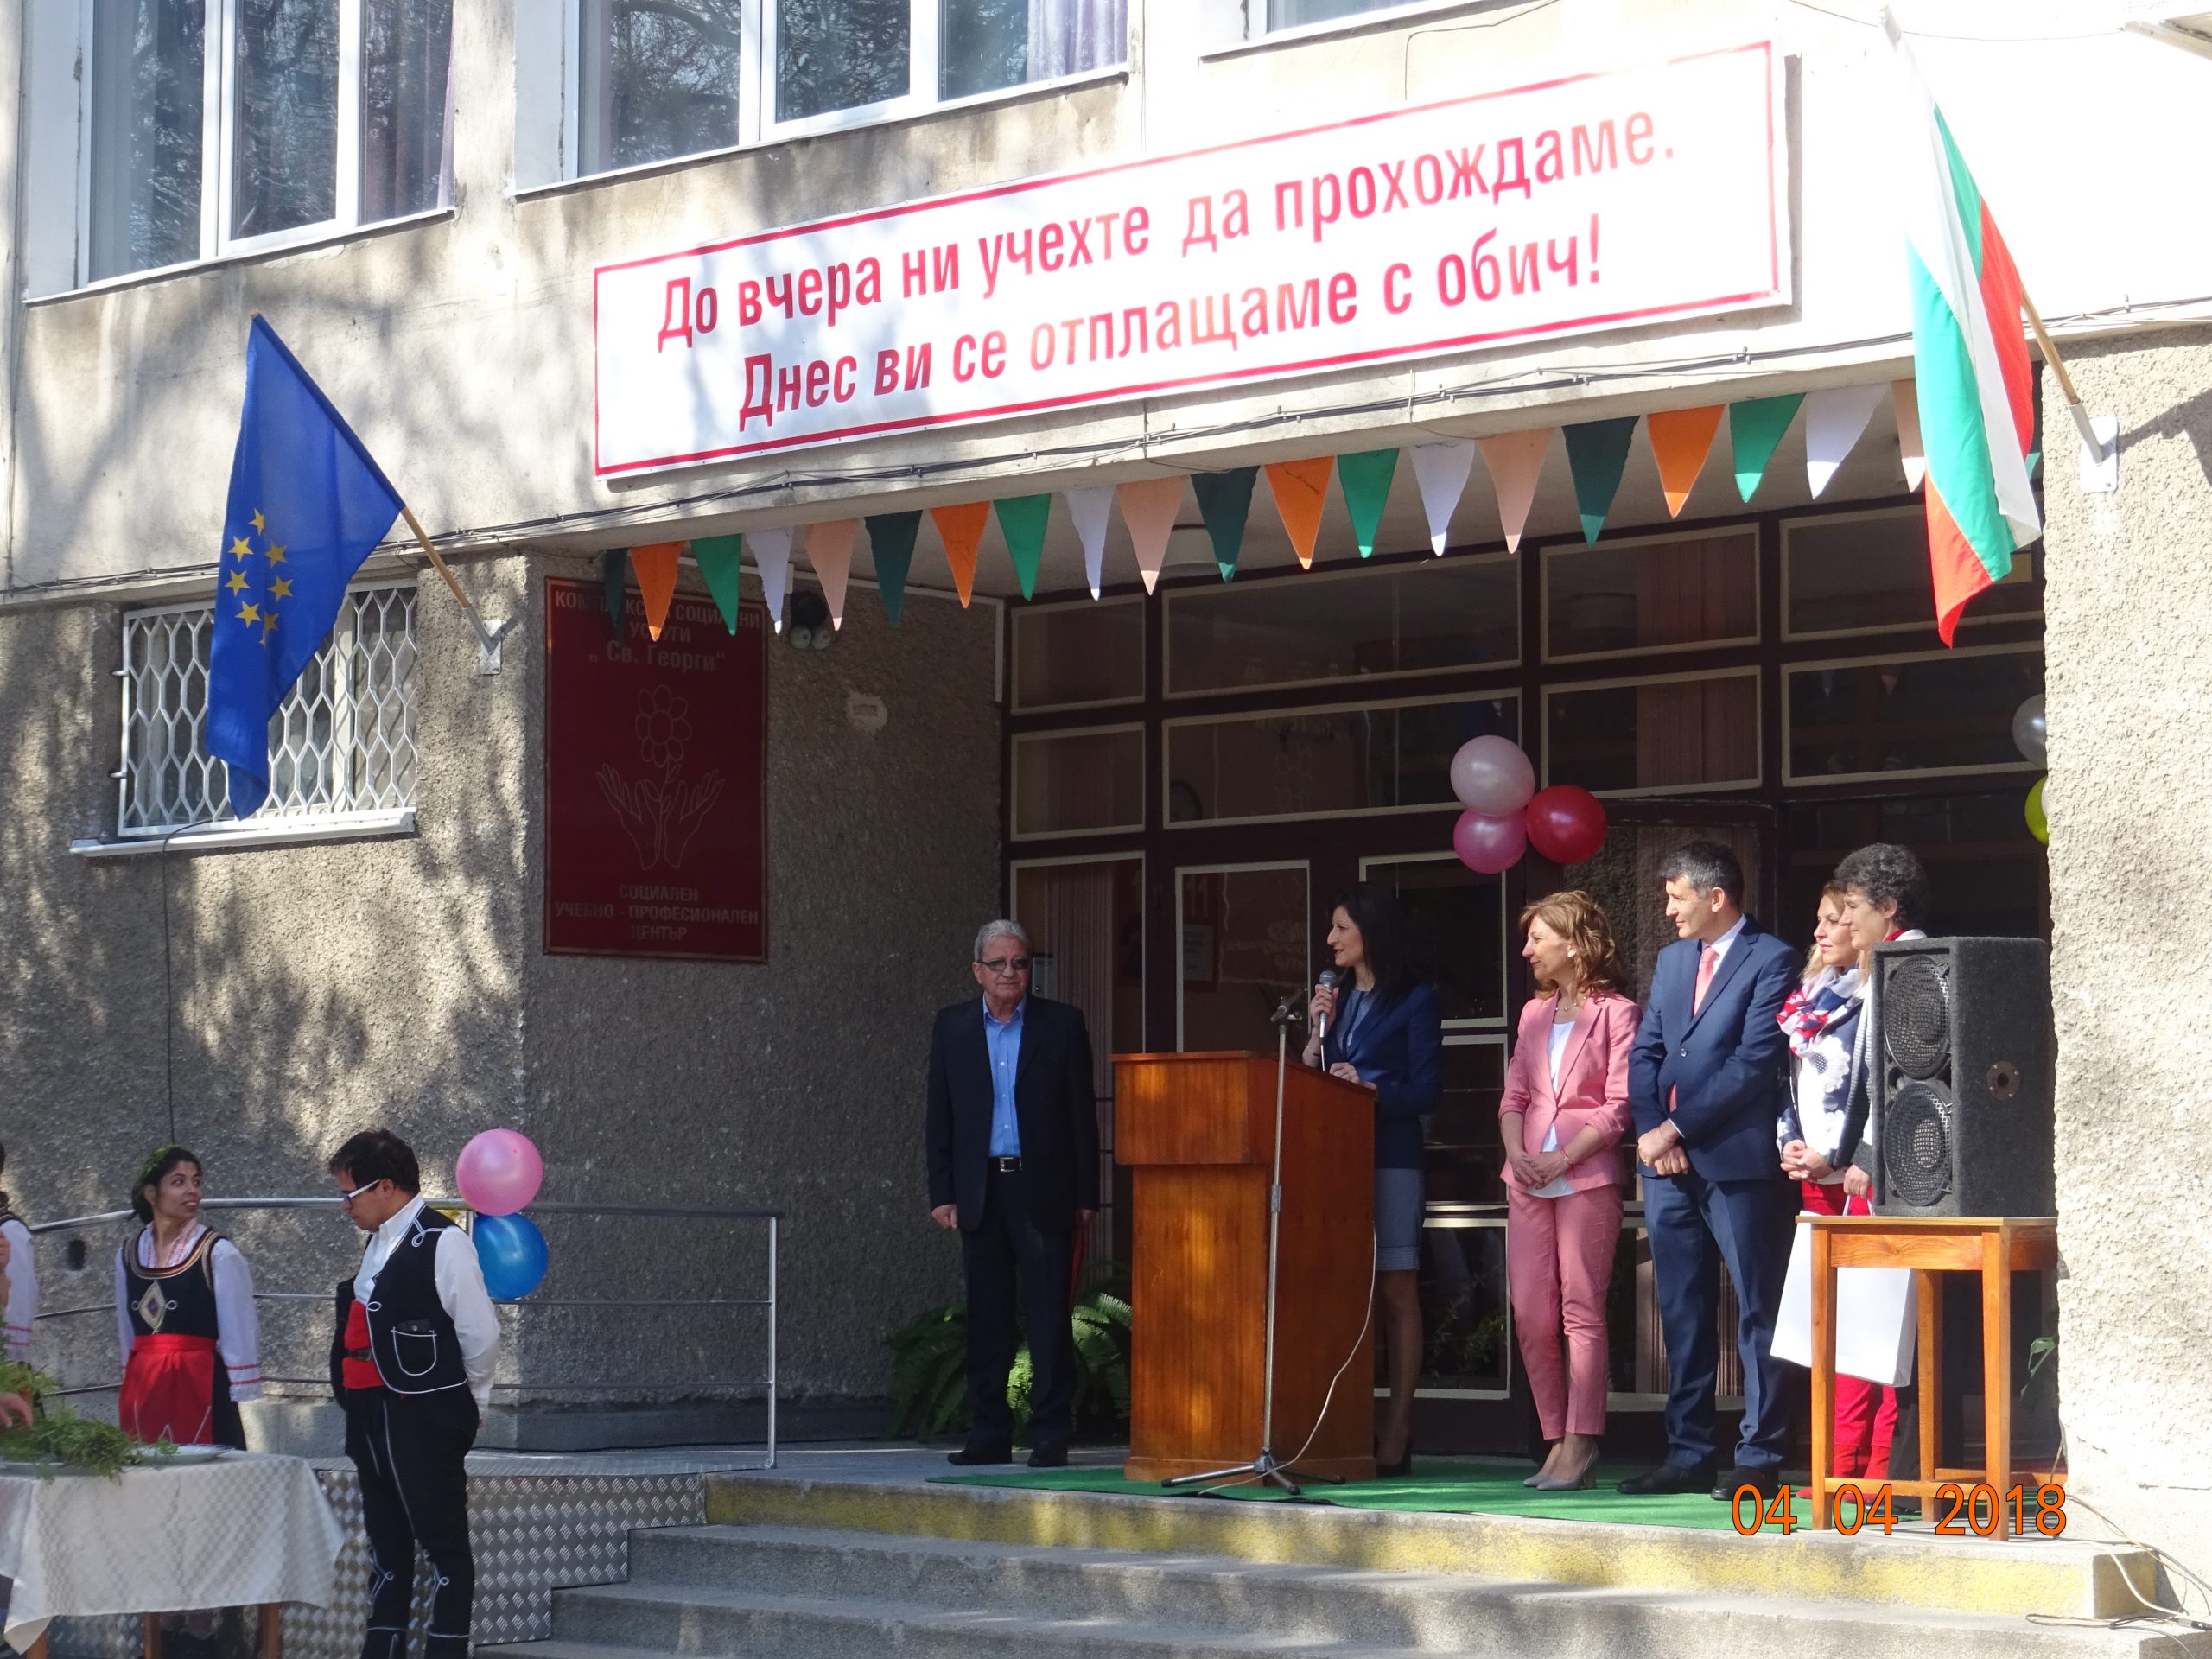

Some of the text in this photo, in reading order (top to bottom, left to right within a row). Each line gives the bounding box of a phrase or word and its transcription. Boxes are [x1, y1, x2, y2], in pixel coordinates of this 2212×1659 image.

[658, 111, 1675, 353] До вчера ни учехте да прохождаме.
[739, 213, 1600, 431] Днес ви се отплащаме с обич!
[676, 604, 760, 628] СОЦИНИ
[630, 622, 690, 643] УСУГИ
[619, 884, 698, 902] СОЦИАЛЕН
[628, 905, 759, 925] ПРОФЕСИОНАЛЕН
[631, 925, 688, 941] ЦЕНТЪР
